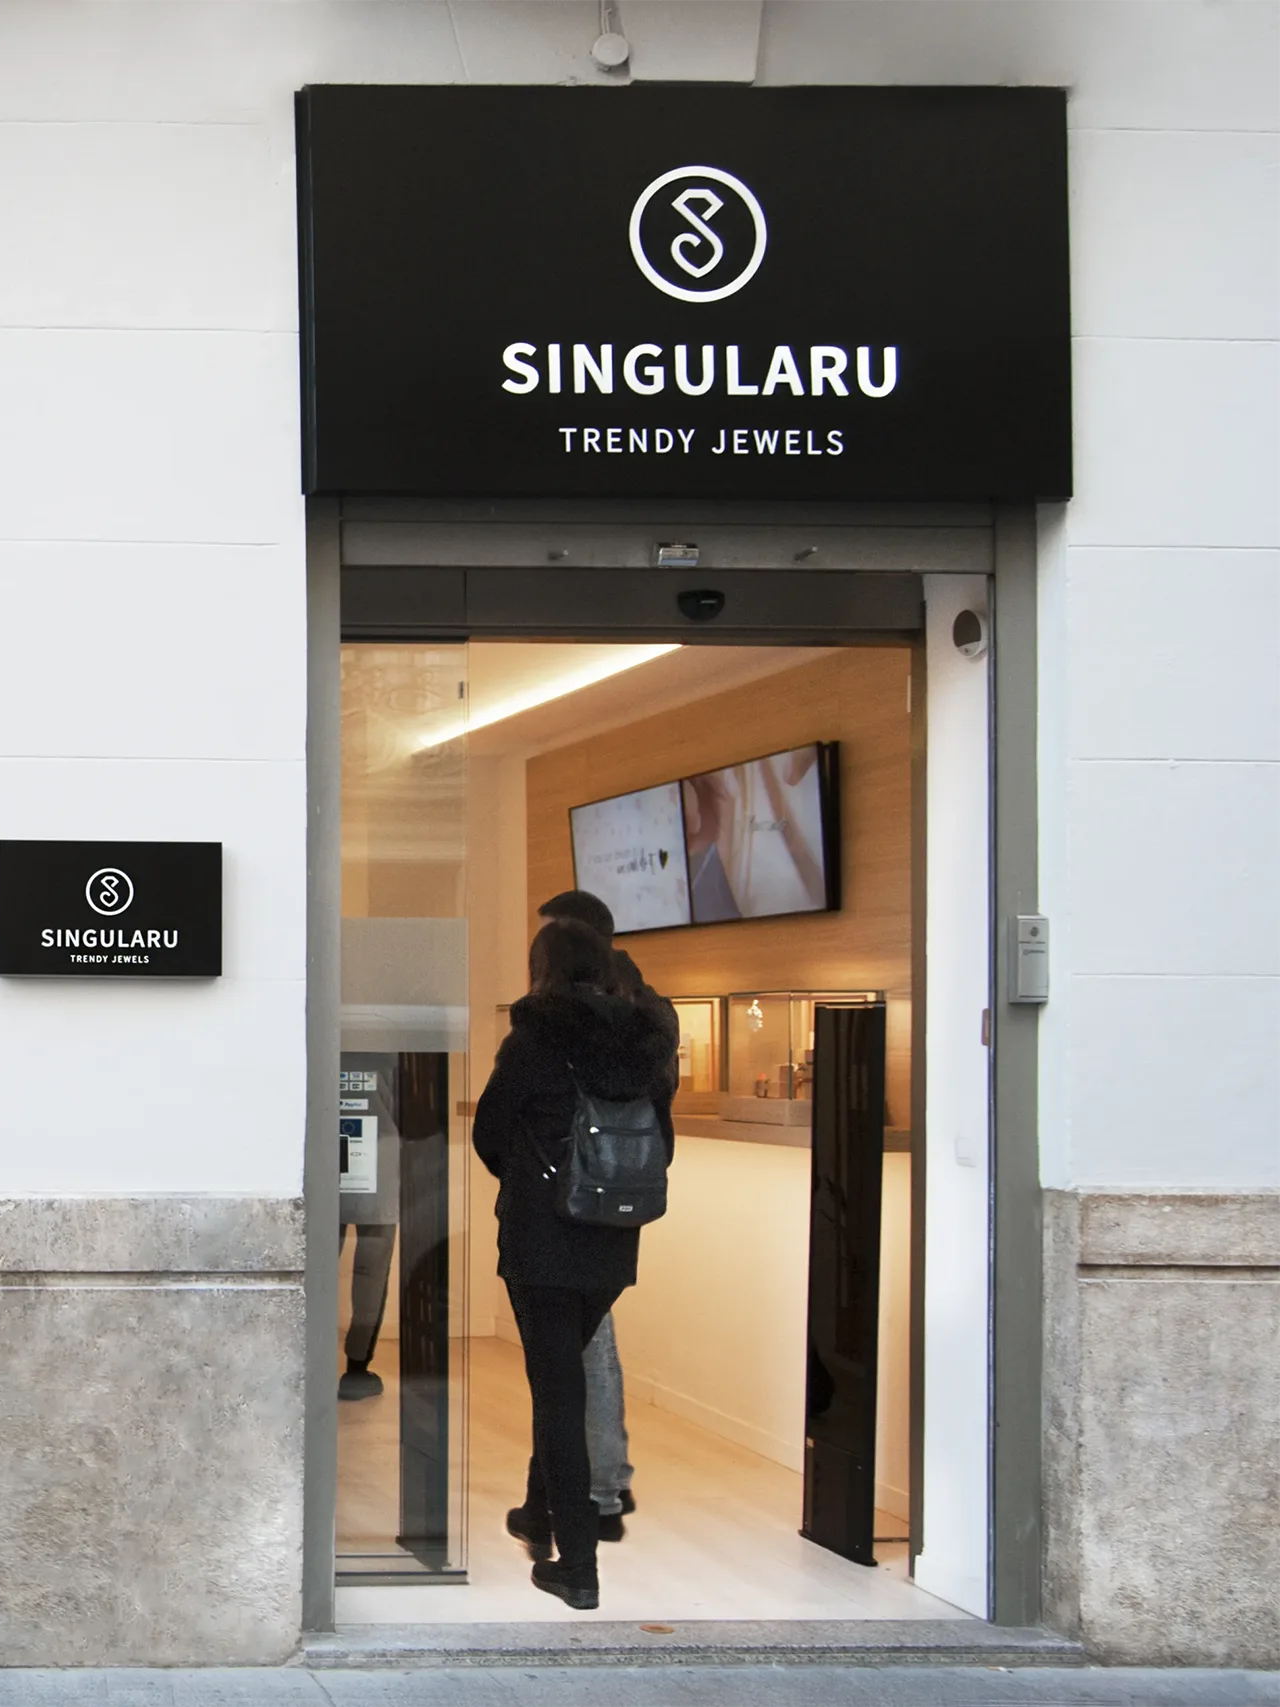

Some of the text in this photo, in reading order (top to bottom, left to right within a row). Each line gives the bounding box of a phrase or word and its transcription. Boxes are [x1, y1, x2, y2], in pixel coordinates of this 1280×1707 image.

[501, 342, 898, 397] SINGULARU
[559, 427, 845, 455] TRENDY JEWELS
[41, 929, 178, 948] SINGULARU
[70, 954, 150, 964] TRENDY JEWELS
